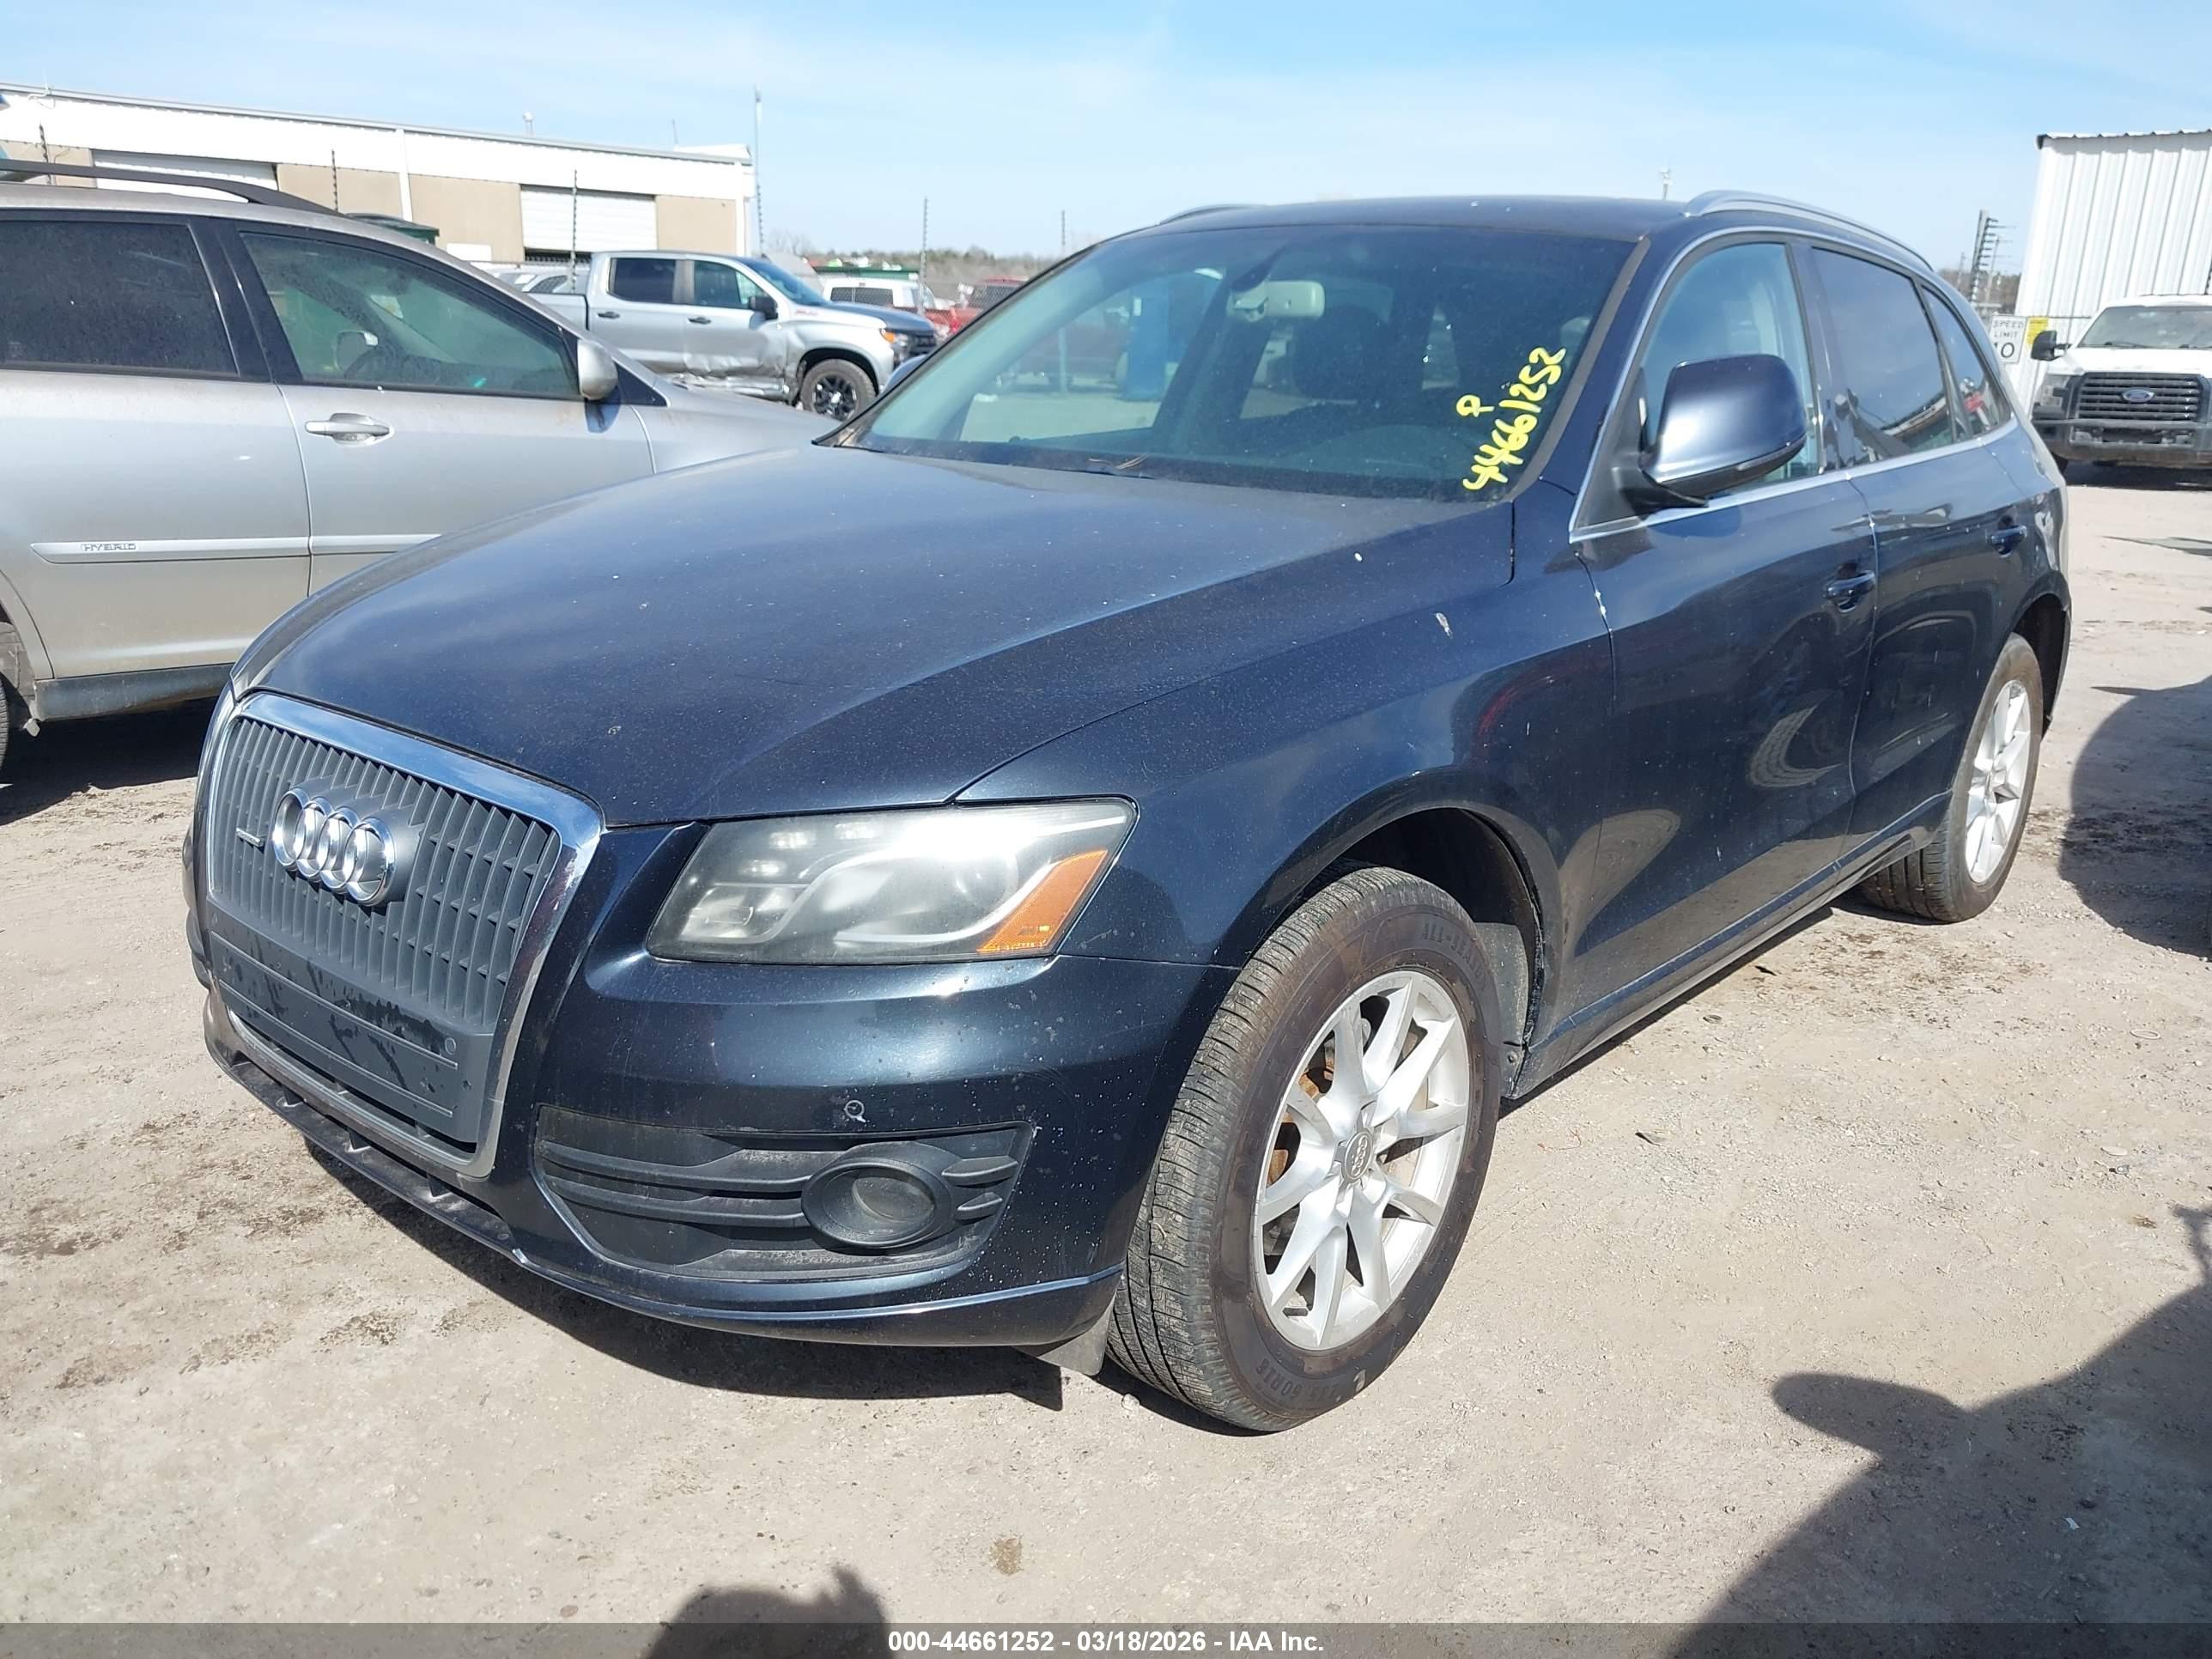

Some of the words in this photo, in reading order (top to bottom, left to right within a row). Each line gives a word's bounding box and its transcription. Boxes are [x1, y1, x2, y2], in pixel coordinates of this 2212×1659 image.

[1992, 319, 2024, 328] SPEED
[1462, 347, 1567, 490] 44661252
[82, 543, 136, 551] HYBRID
